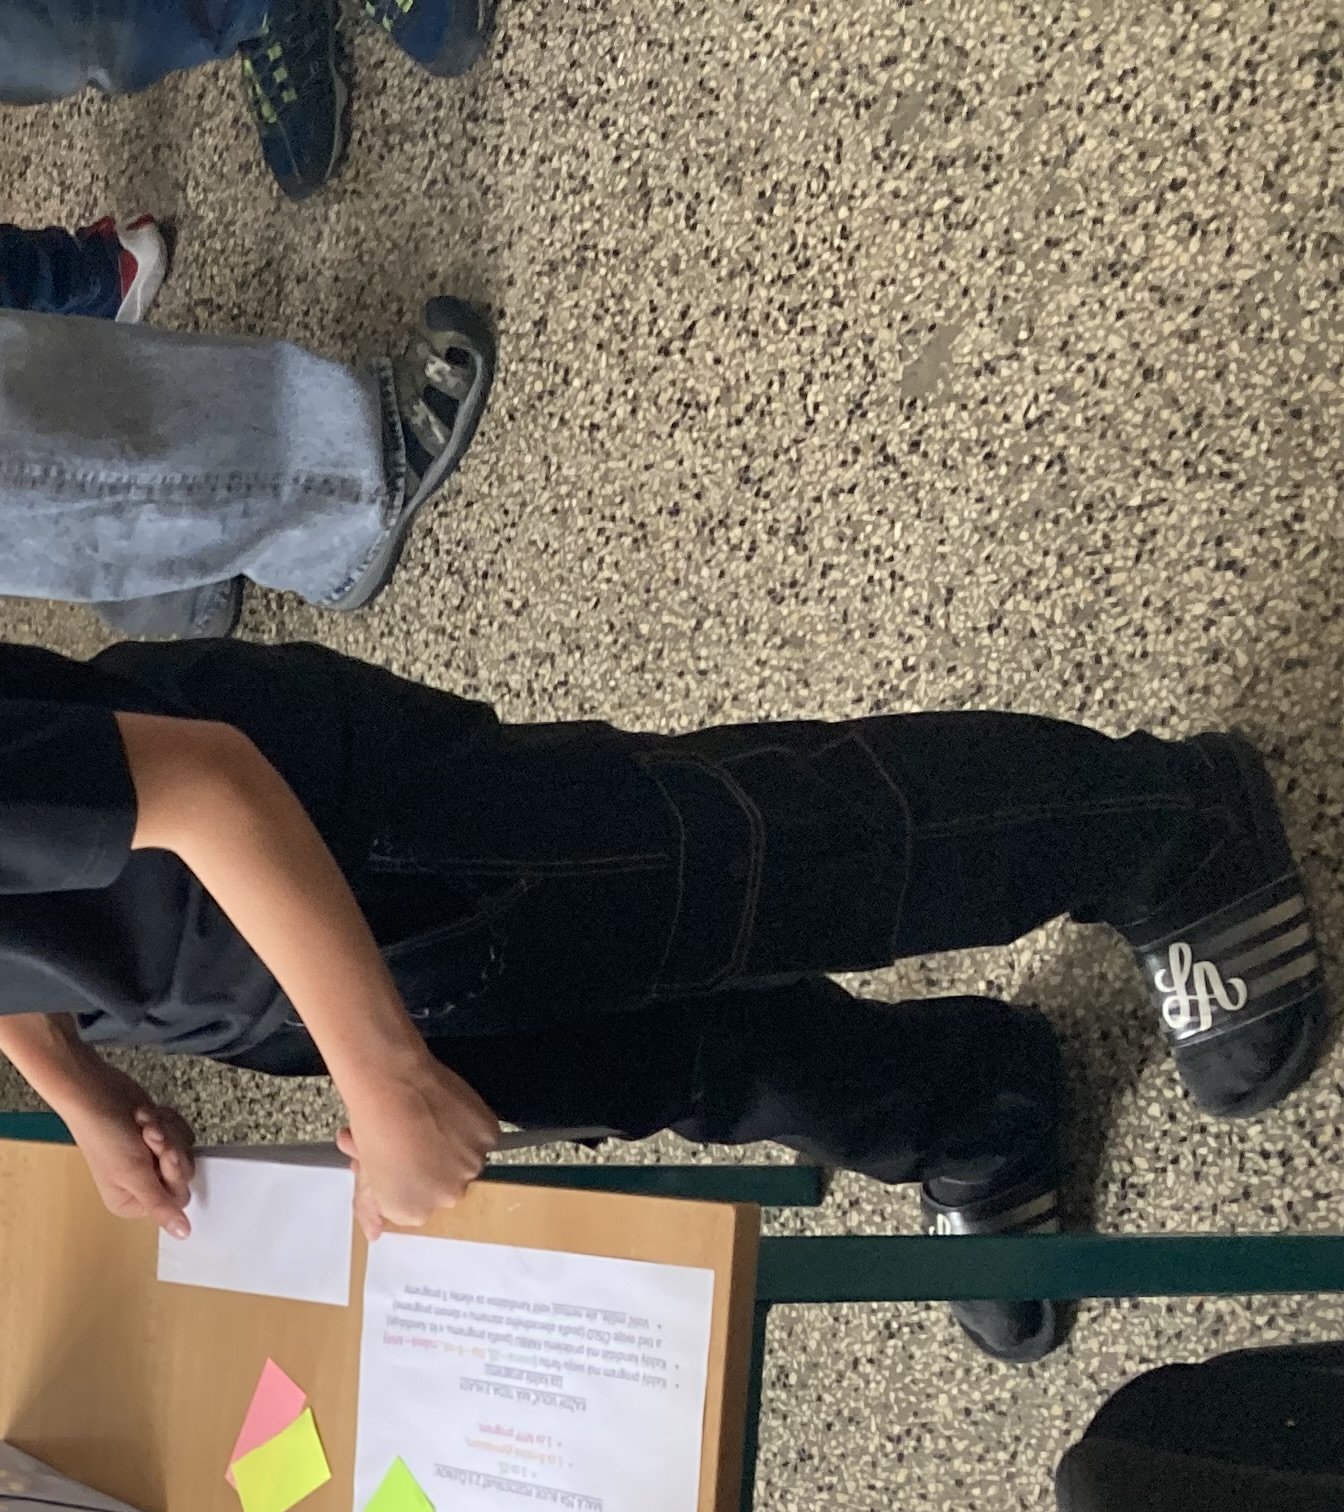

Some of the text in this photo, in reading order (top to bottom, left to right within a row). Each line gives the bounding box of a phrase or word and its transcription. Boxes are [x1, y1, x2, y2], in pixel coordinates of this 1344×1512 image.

[640, 1354, 666, 1369] Každý
[602, 1367, 639, 1384] program
[641, 1374, 666, 1388] Každý
